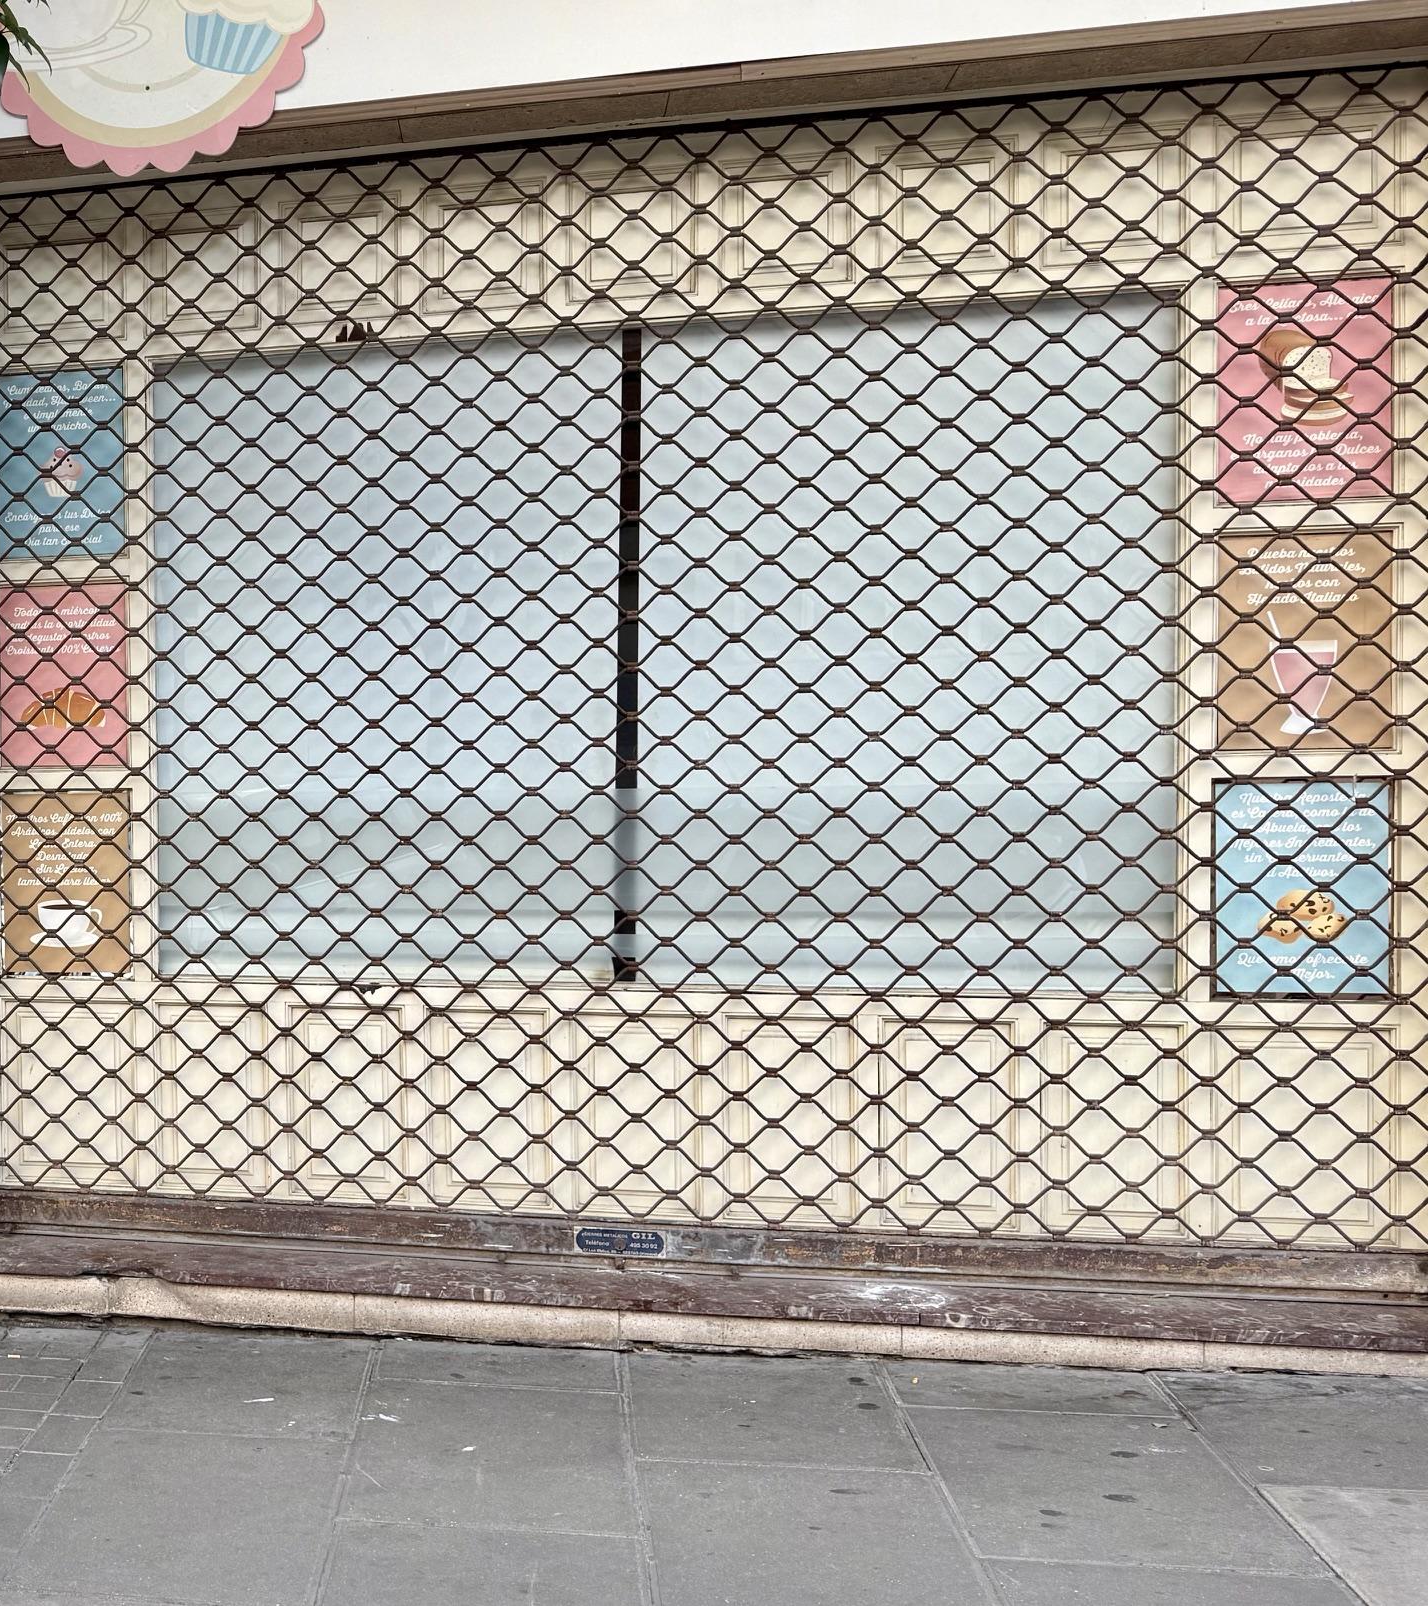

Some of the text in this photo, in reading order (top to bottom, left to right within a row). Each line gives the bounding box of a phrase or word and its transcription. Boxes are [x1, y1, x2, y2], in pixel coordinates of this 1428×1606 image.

[1242, 433, 1263, 446] No
[1334, 444, 1382, 456] Dulces
[1315, 578, 1340, 587] con
[1305, 809, 1340, 817] como
[1244, 853, 1263, 863] sin
[631, 1232, 656, 1240] GIL
